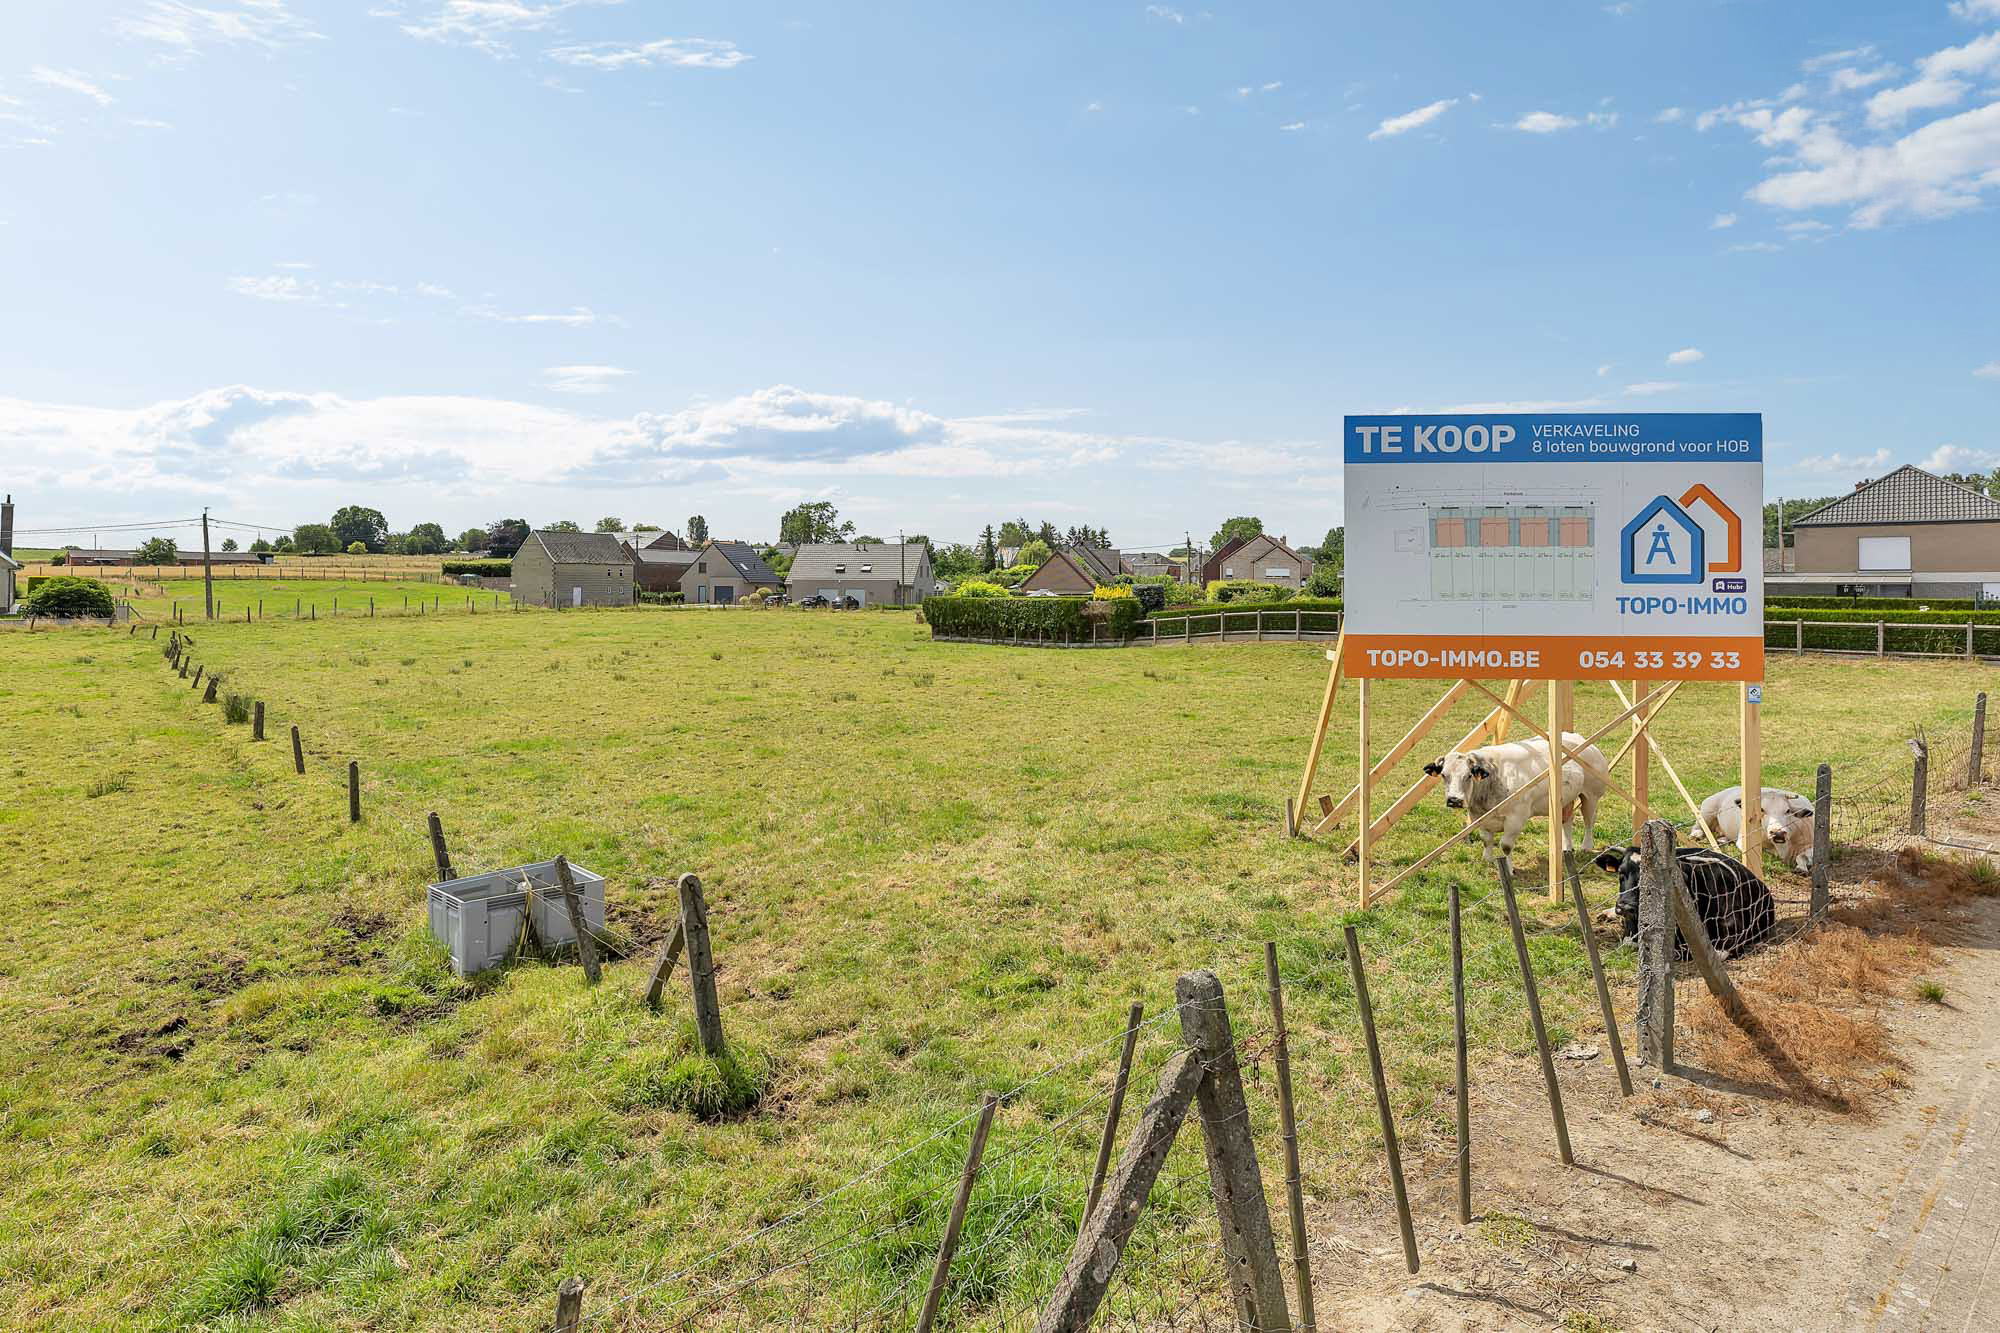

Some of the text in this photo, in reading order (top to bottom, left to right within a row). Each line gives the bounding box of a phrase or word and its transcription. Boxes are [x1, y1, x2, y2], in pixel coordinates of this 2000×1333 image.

[1356, 425, 1516, 453] TE KOOP
[1532, 424, 1640, 437] VERKAVELING
[1532, 440, 1750, 457] 8 loten bouwgrond voor HOB
[1616, 597, 1747, 615] TOPO-IMMO
[1367, 650, 1540, 668] TOPO-IMMO.BE
[1579, 650, 1741, 669] 054 33 39 33
